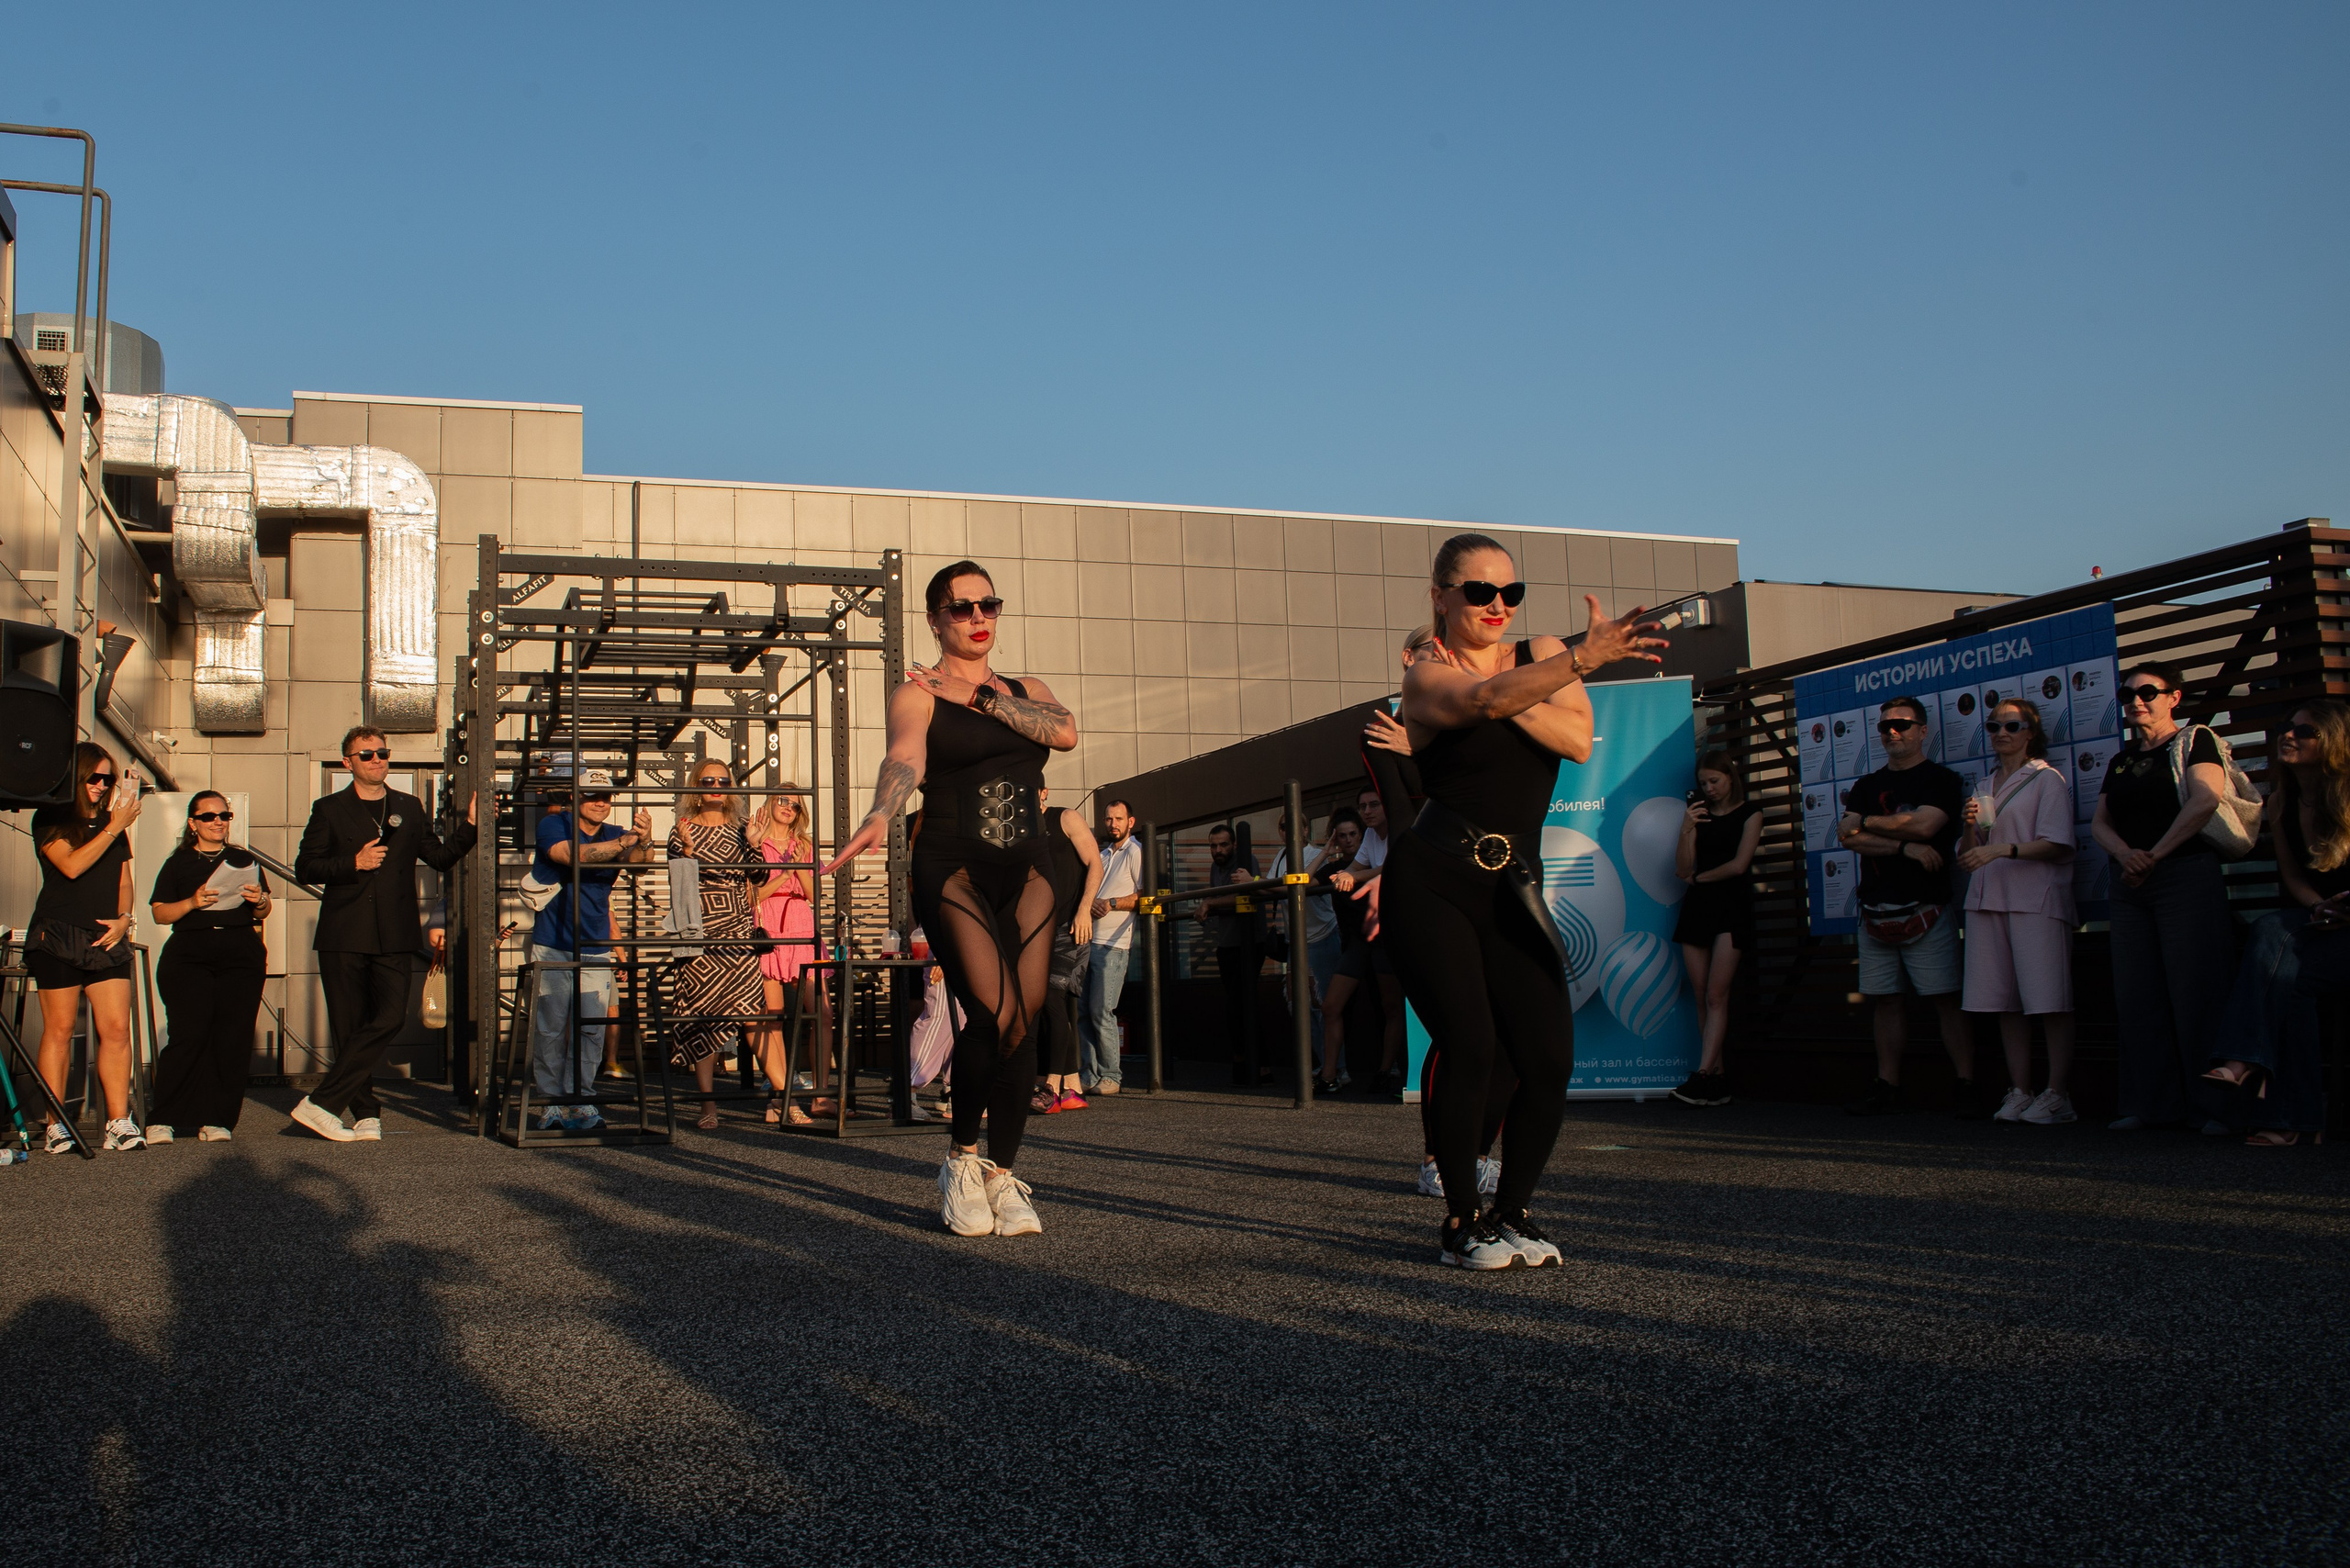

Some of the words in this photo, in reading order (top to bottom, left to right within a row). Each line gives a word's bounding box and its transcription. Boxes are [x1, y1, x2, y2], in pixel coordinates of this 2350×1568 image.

[512, 575, 547, 603] ALFAFIT
[1854, 655, 1944, 694] ИСТОРИИ
[1948, 637, 2032, 674] УСПЕХА
[1573, 1058, 1598, 1069] ный
[1601, 1058, 1622, 1068] зал
[1636, 1056, 1688, 1067] бассейн
[1605, 1074, 1688, 1085] www.gymatica.ru
